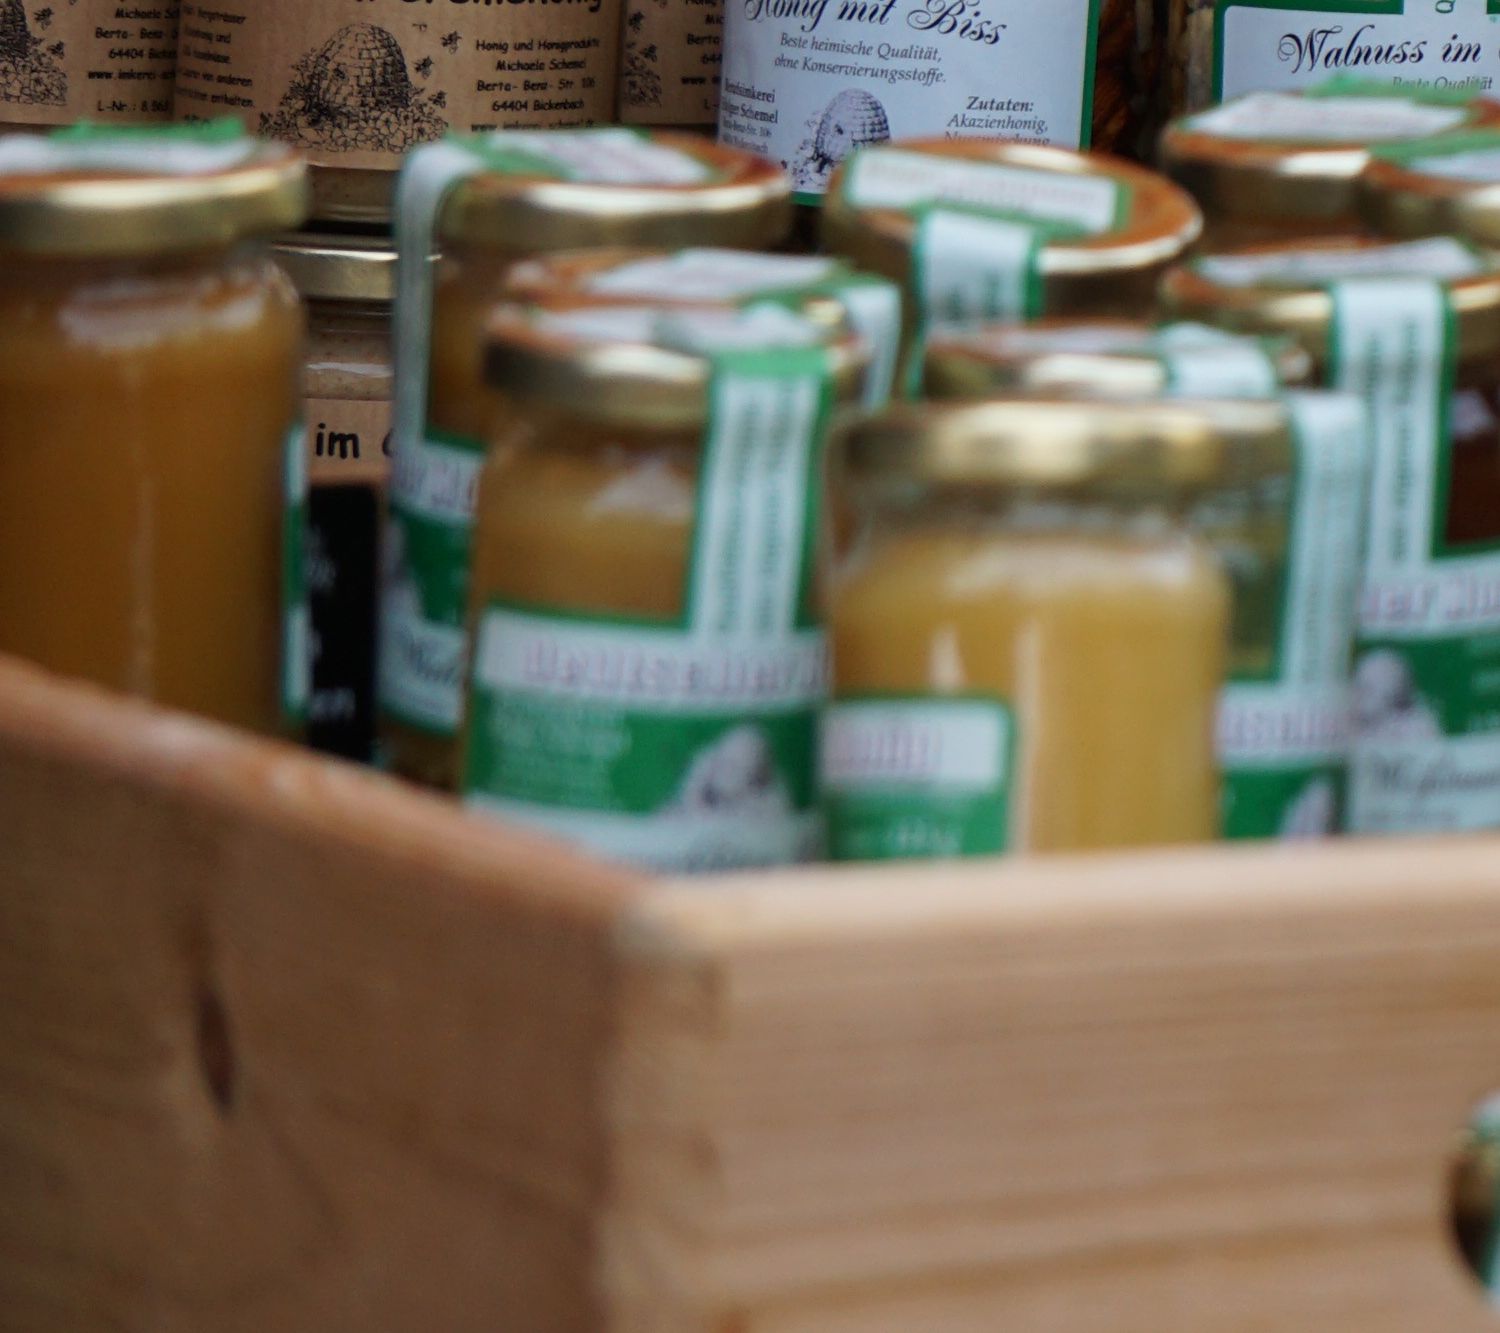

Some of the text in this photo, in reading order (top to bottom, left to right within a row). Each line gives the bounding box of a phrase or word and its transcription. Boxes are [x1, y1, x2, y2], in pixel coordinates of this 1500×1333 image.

[109, 48, 144, 60] 64404
[475, 38, 508, 53] Honig
[514, 39, 534, 51] und
[780, 32, 943, 63] Beste heimische Qualität,
[1277, 24, 1427, 73] Walnuss
[1441, 33, 1481, 63] im
[496, 59, 545, 72] Michaela
[774, 54, 948, 87] ohne Konservierungsstoffe.
[1435, 76, 1493, 90] Qualität
[492, 98, 585, 112] 64404 Bickenbach
[966, 95, 1034, 113] Zutaten:
[740, 104, 779, 124] Schemel
[947, 112, 1049, 132] Akazienhonig,
[313, 423, 362, 462] im
